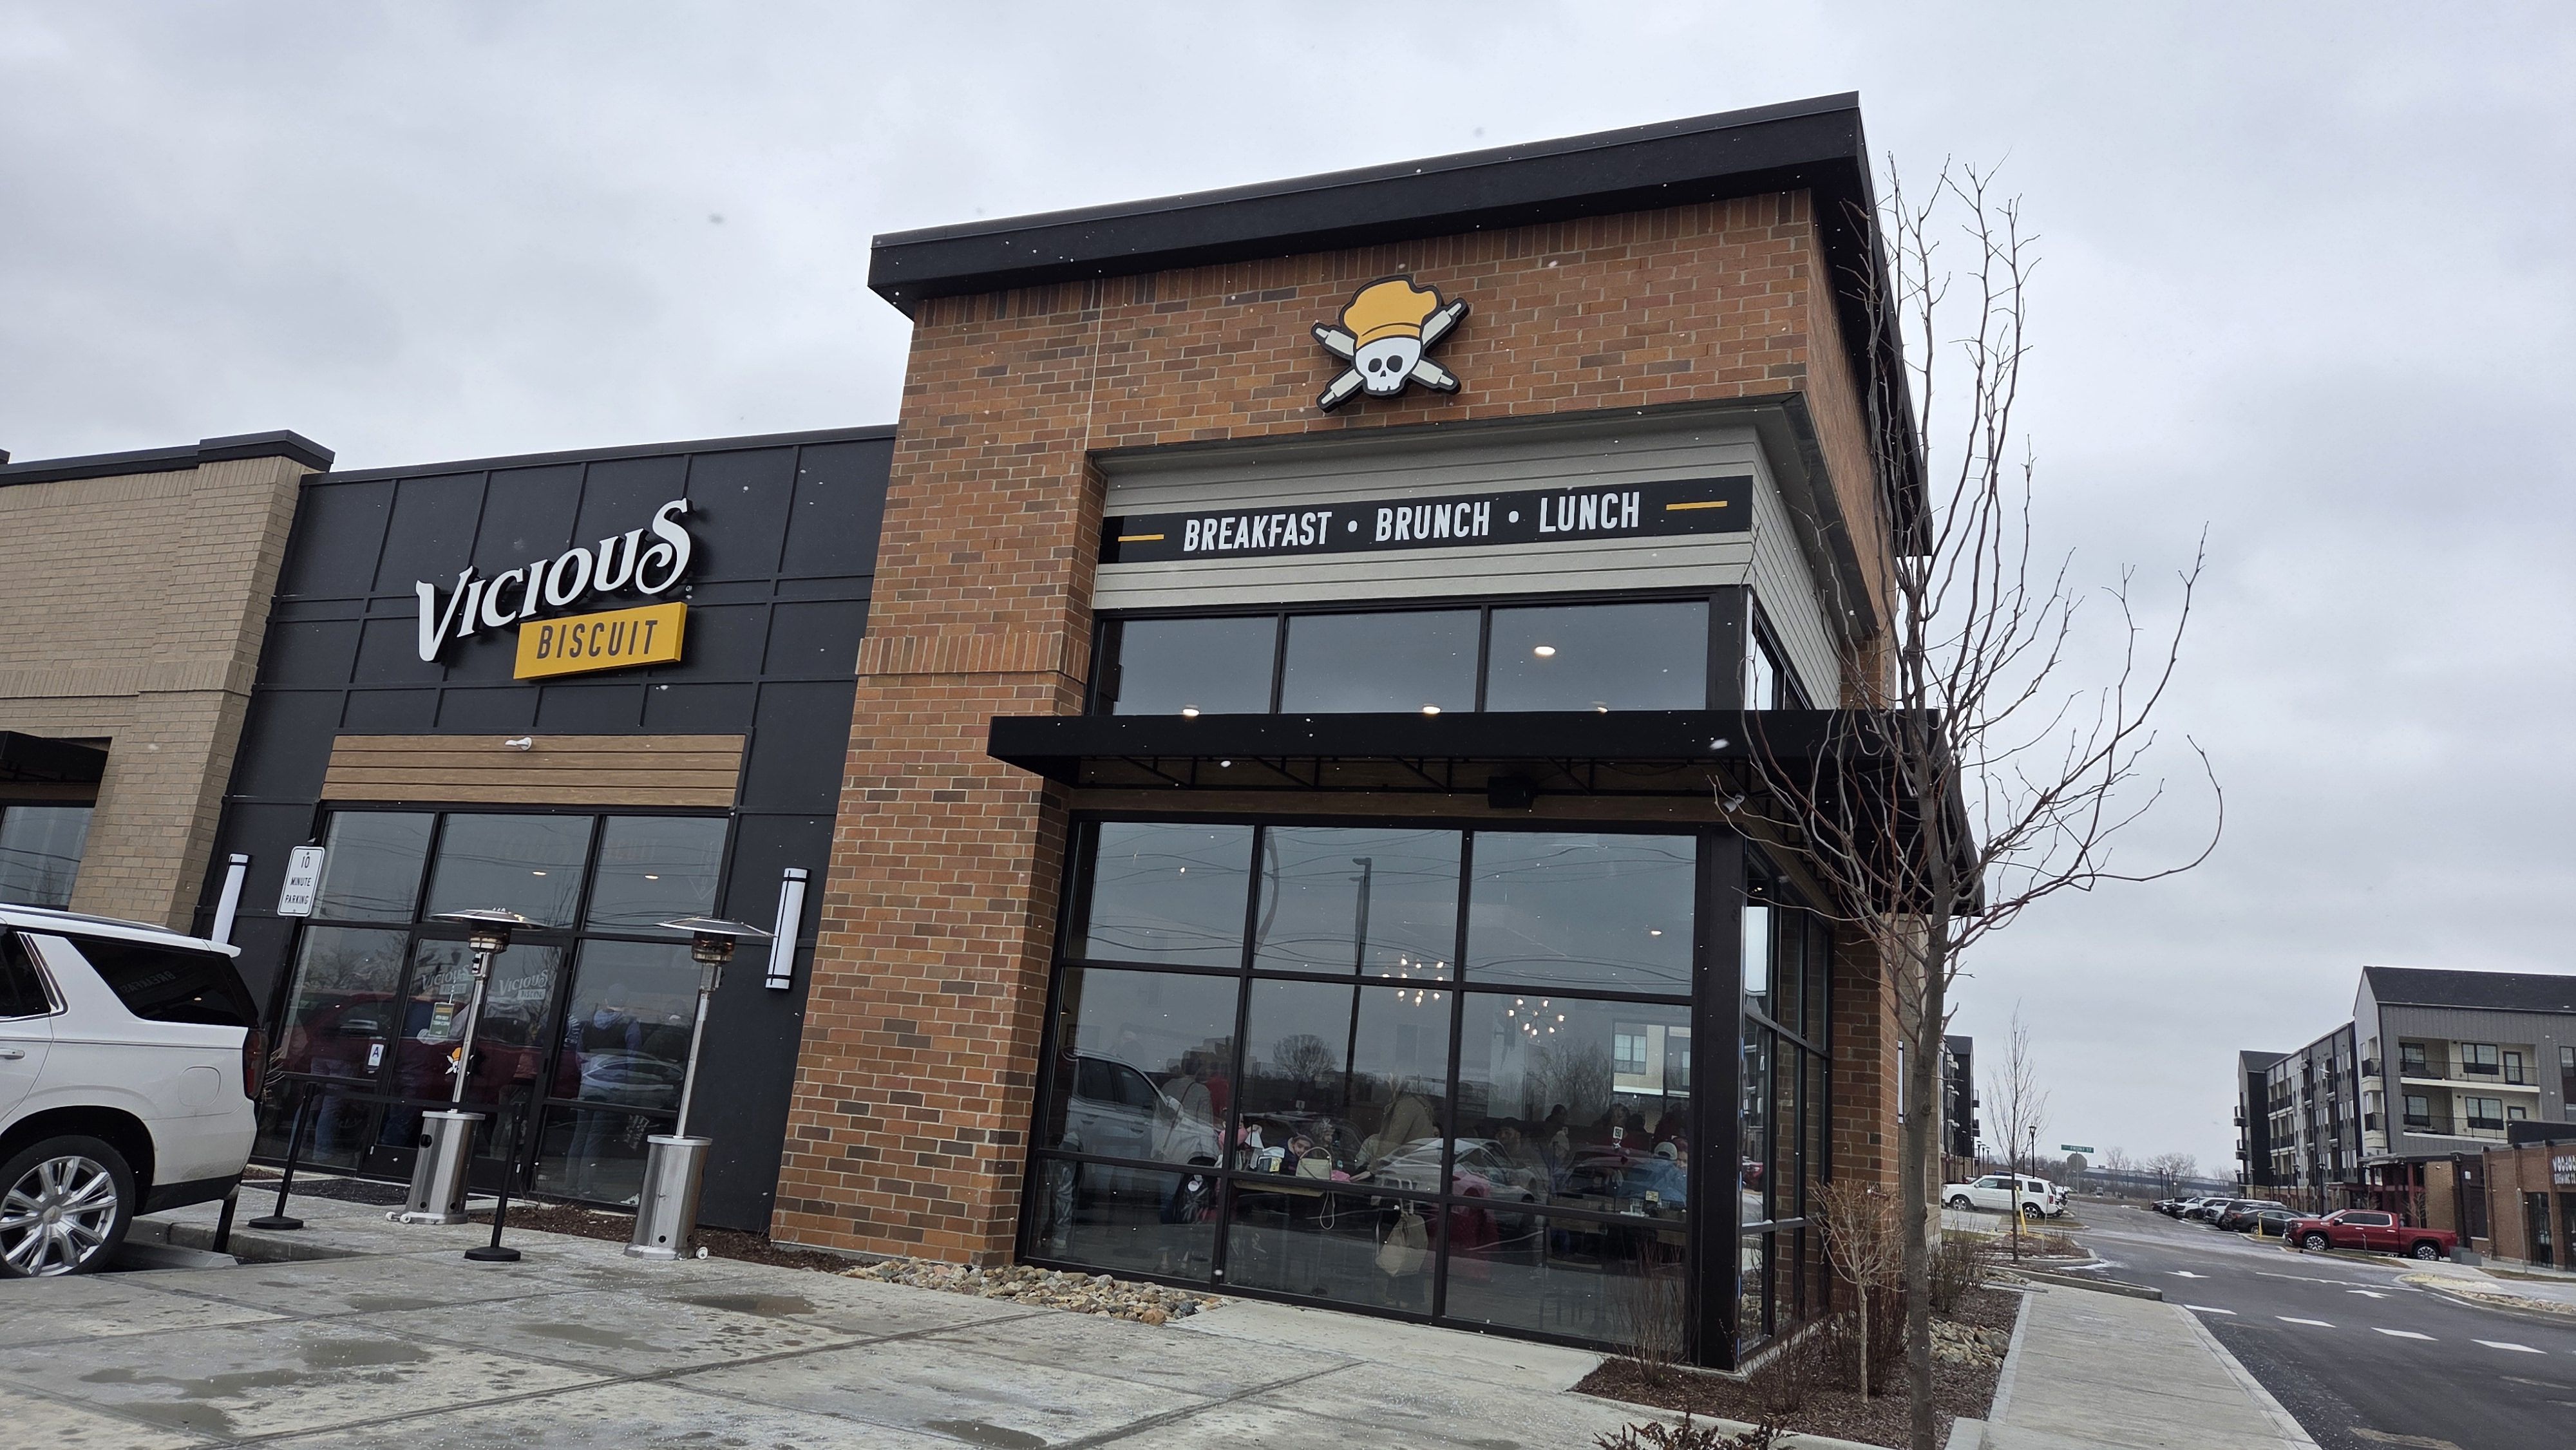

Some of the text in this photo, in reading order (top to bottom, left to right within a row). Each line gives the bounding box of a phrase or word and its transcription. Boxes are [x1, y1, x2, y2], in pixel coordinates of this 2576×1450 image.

[1183, 491, 1640, 552] BREAKFAST BRUNCH LUNCH
[415, 497, 691, 662] VICIOUS
[536, 619, 658, 659] BISCUIT
[301, 856, 310, 868] 10
[290, 877, 312, 887] MINUTE
[285, 894, 309, 905] PARKING
[499, 969, 548, 996] VICIOUS
[372, 1046, 379, 1057] A
